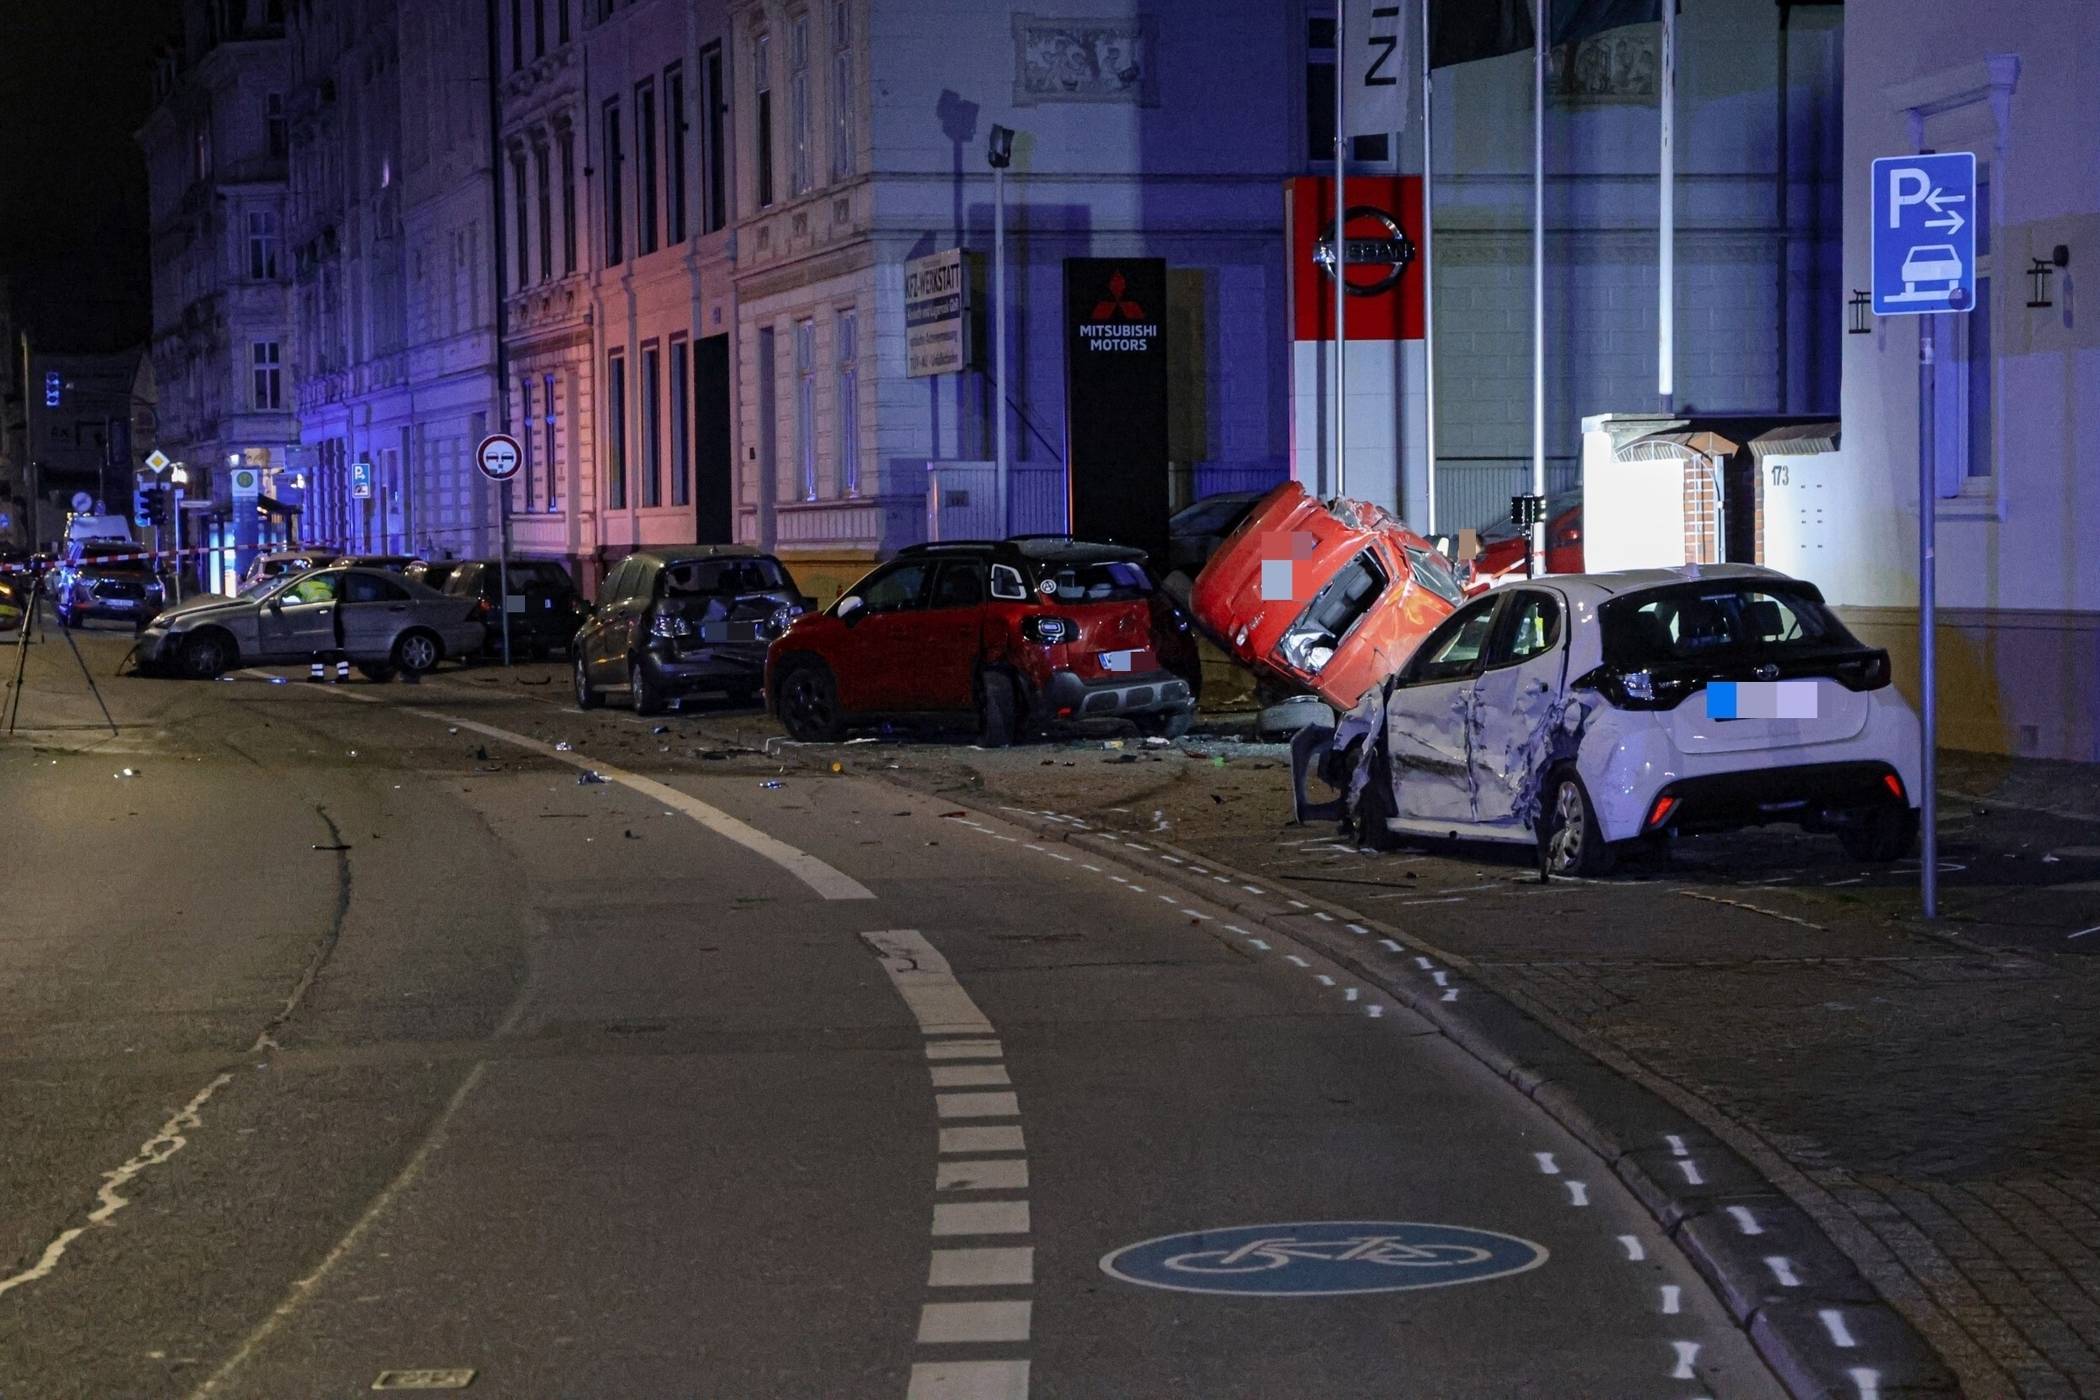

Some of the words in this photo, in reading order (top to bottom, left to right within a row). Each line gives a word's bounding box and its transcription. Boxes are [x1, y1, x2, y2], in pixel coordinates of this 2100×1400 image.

[1890, 168, 1931, 229] P
[905, 263, 960, 299] KFZ-WERKSTATT
[1080, 325, 1157, 337] MITSUBISHI
[1090, 338, 1148, 351] MOTORS
[1771, 465, 1790, 486] 173
